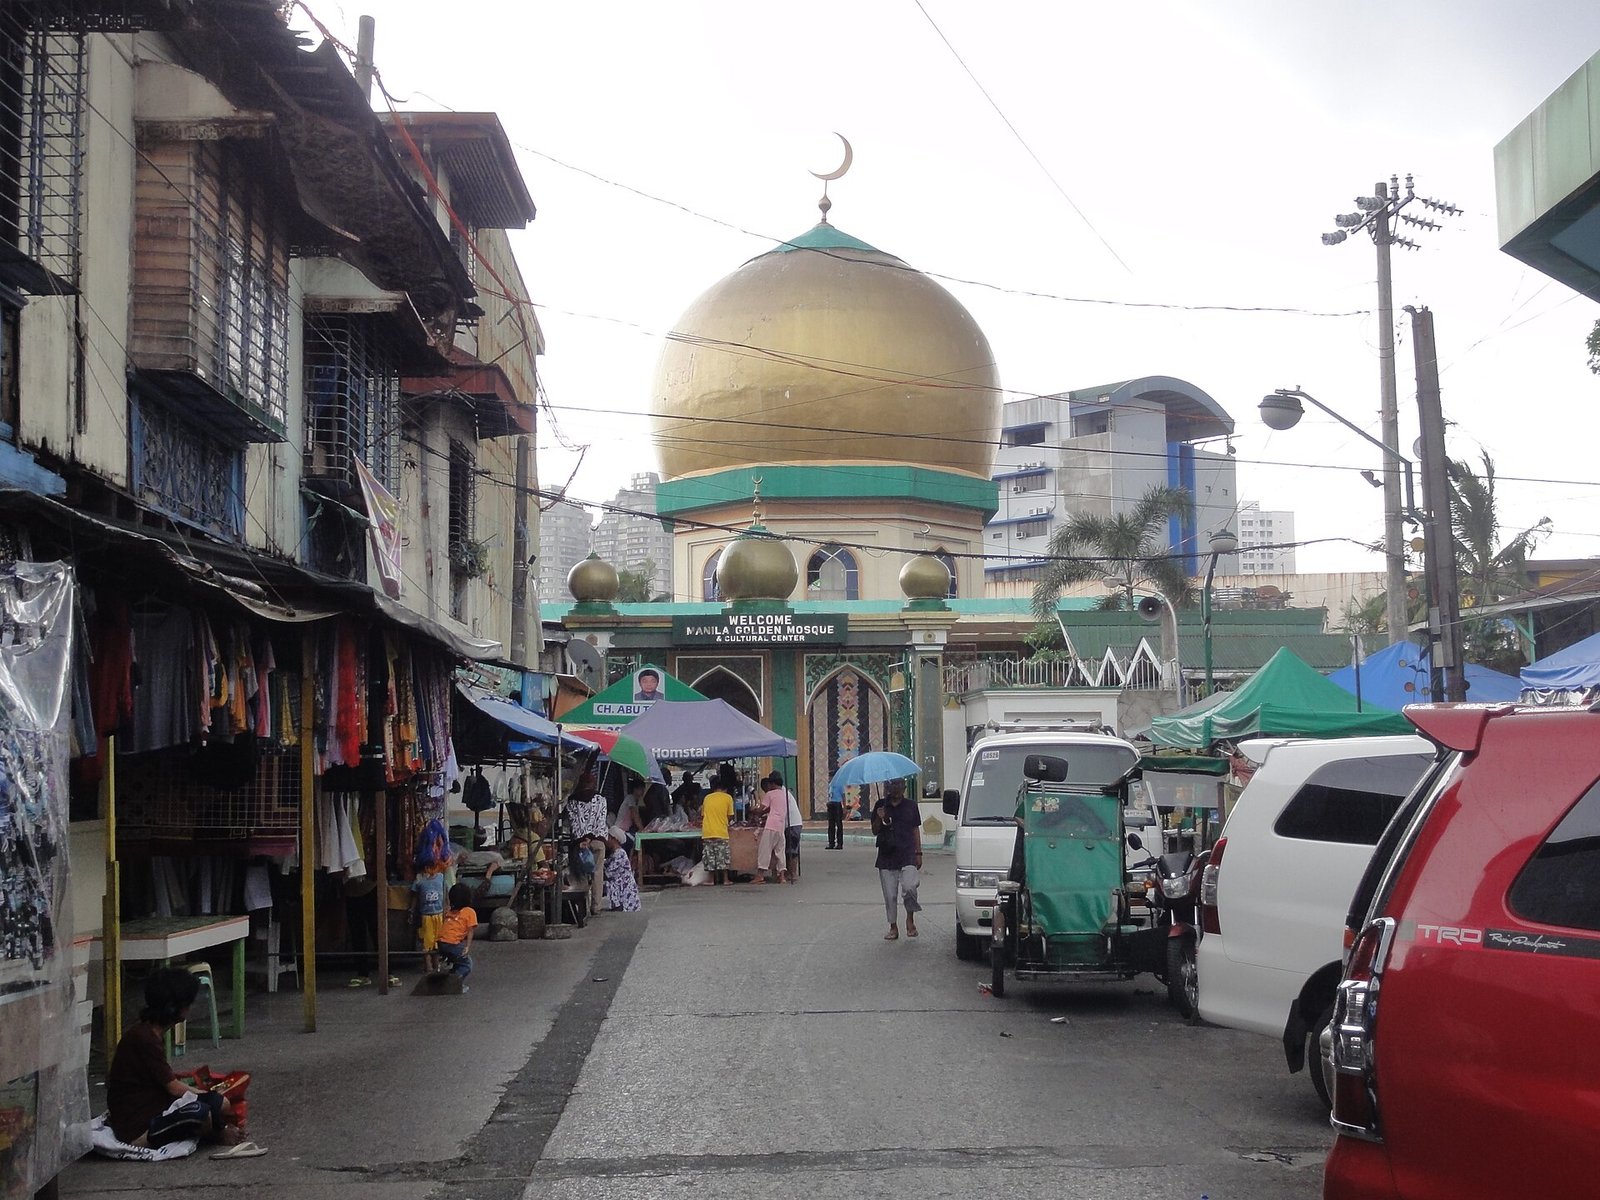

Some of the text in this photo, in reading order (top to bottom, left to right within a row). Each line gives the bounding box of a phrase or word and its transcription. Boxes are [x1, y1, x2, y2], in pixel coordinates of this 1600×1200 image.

[729, 615, 792, 625] WELCOME
[686, 625, 834, 636] MANILA GOLDEN MOSQUE
[596, 704, 615, 714] CH.
[617, 705, 640, 714] ABU
[652, 746, 710, 759] Homstar
[1418, 925, 1481, 945] TRD
